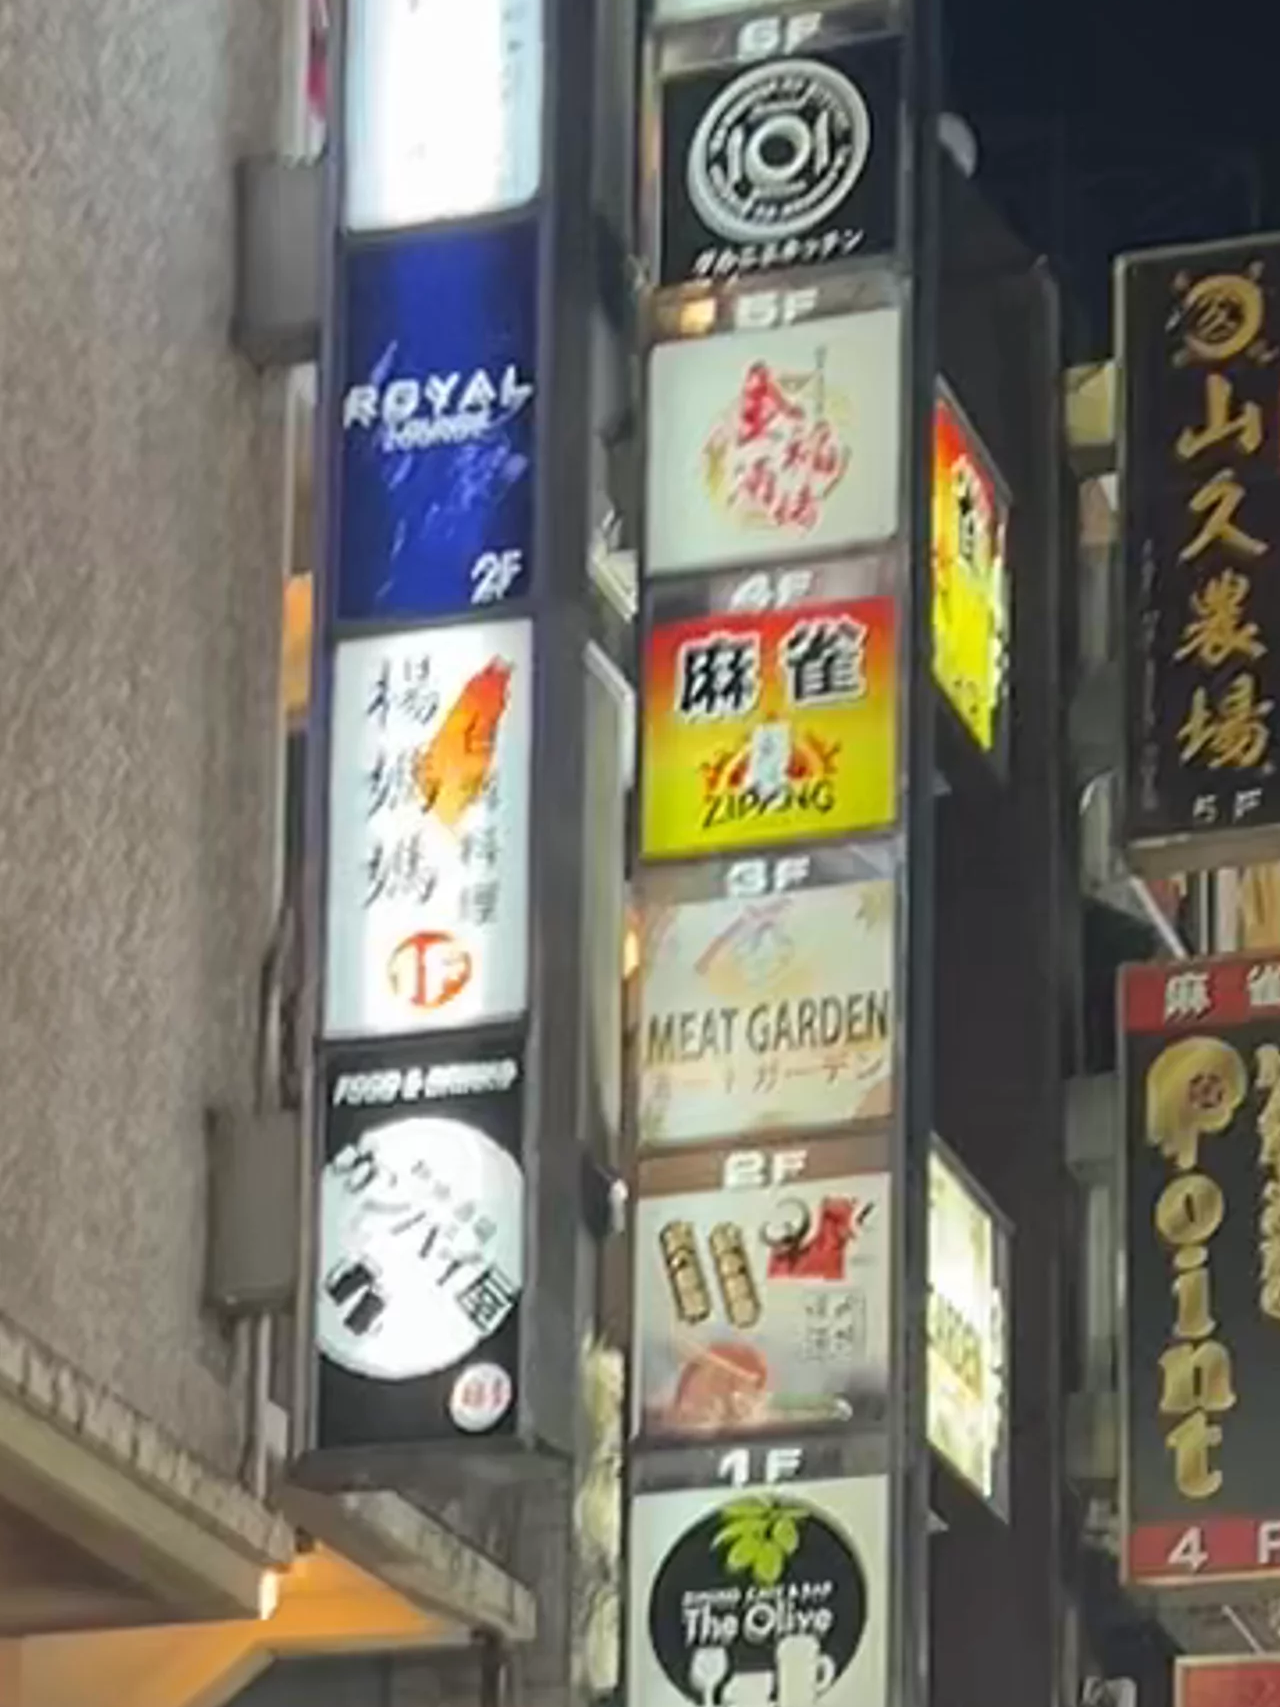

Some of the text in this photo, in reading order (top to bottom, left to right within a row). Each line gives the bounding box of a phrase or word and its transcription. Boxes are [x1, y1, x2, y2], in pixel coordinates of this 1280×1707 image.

[342, 363, 533, 430] ROYAL
[470, 548, 523, 605] 2F
[676, 618, 868, 723] 麻雀
[646, 990, 891, 1067] MEAT GARDEN
[722, 1149, 809, 1189] 2F
[717, 1447, 804, 1489] 1F
[683, 1599, 834, 1646] The Olive
